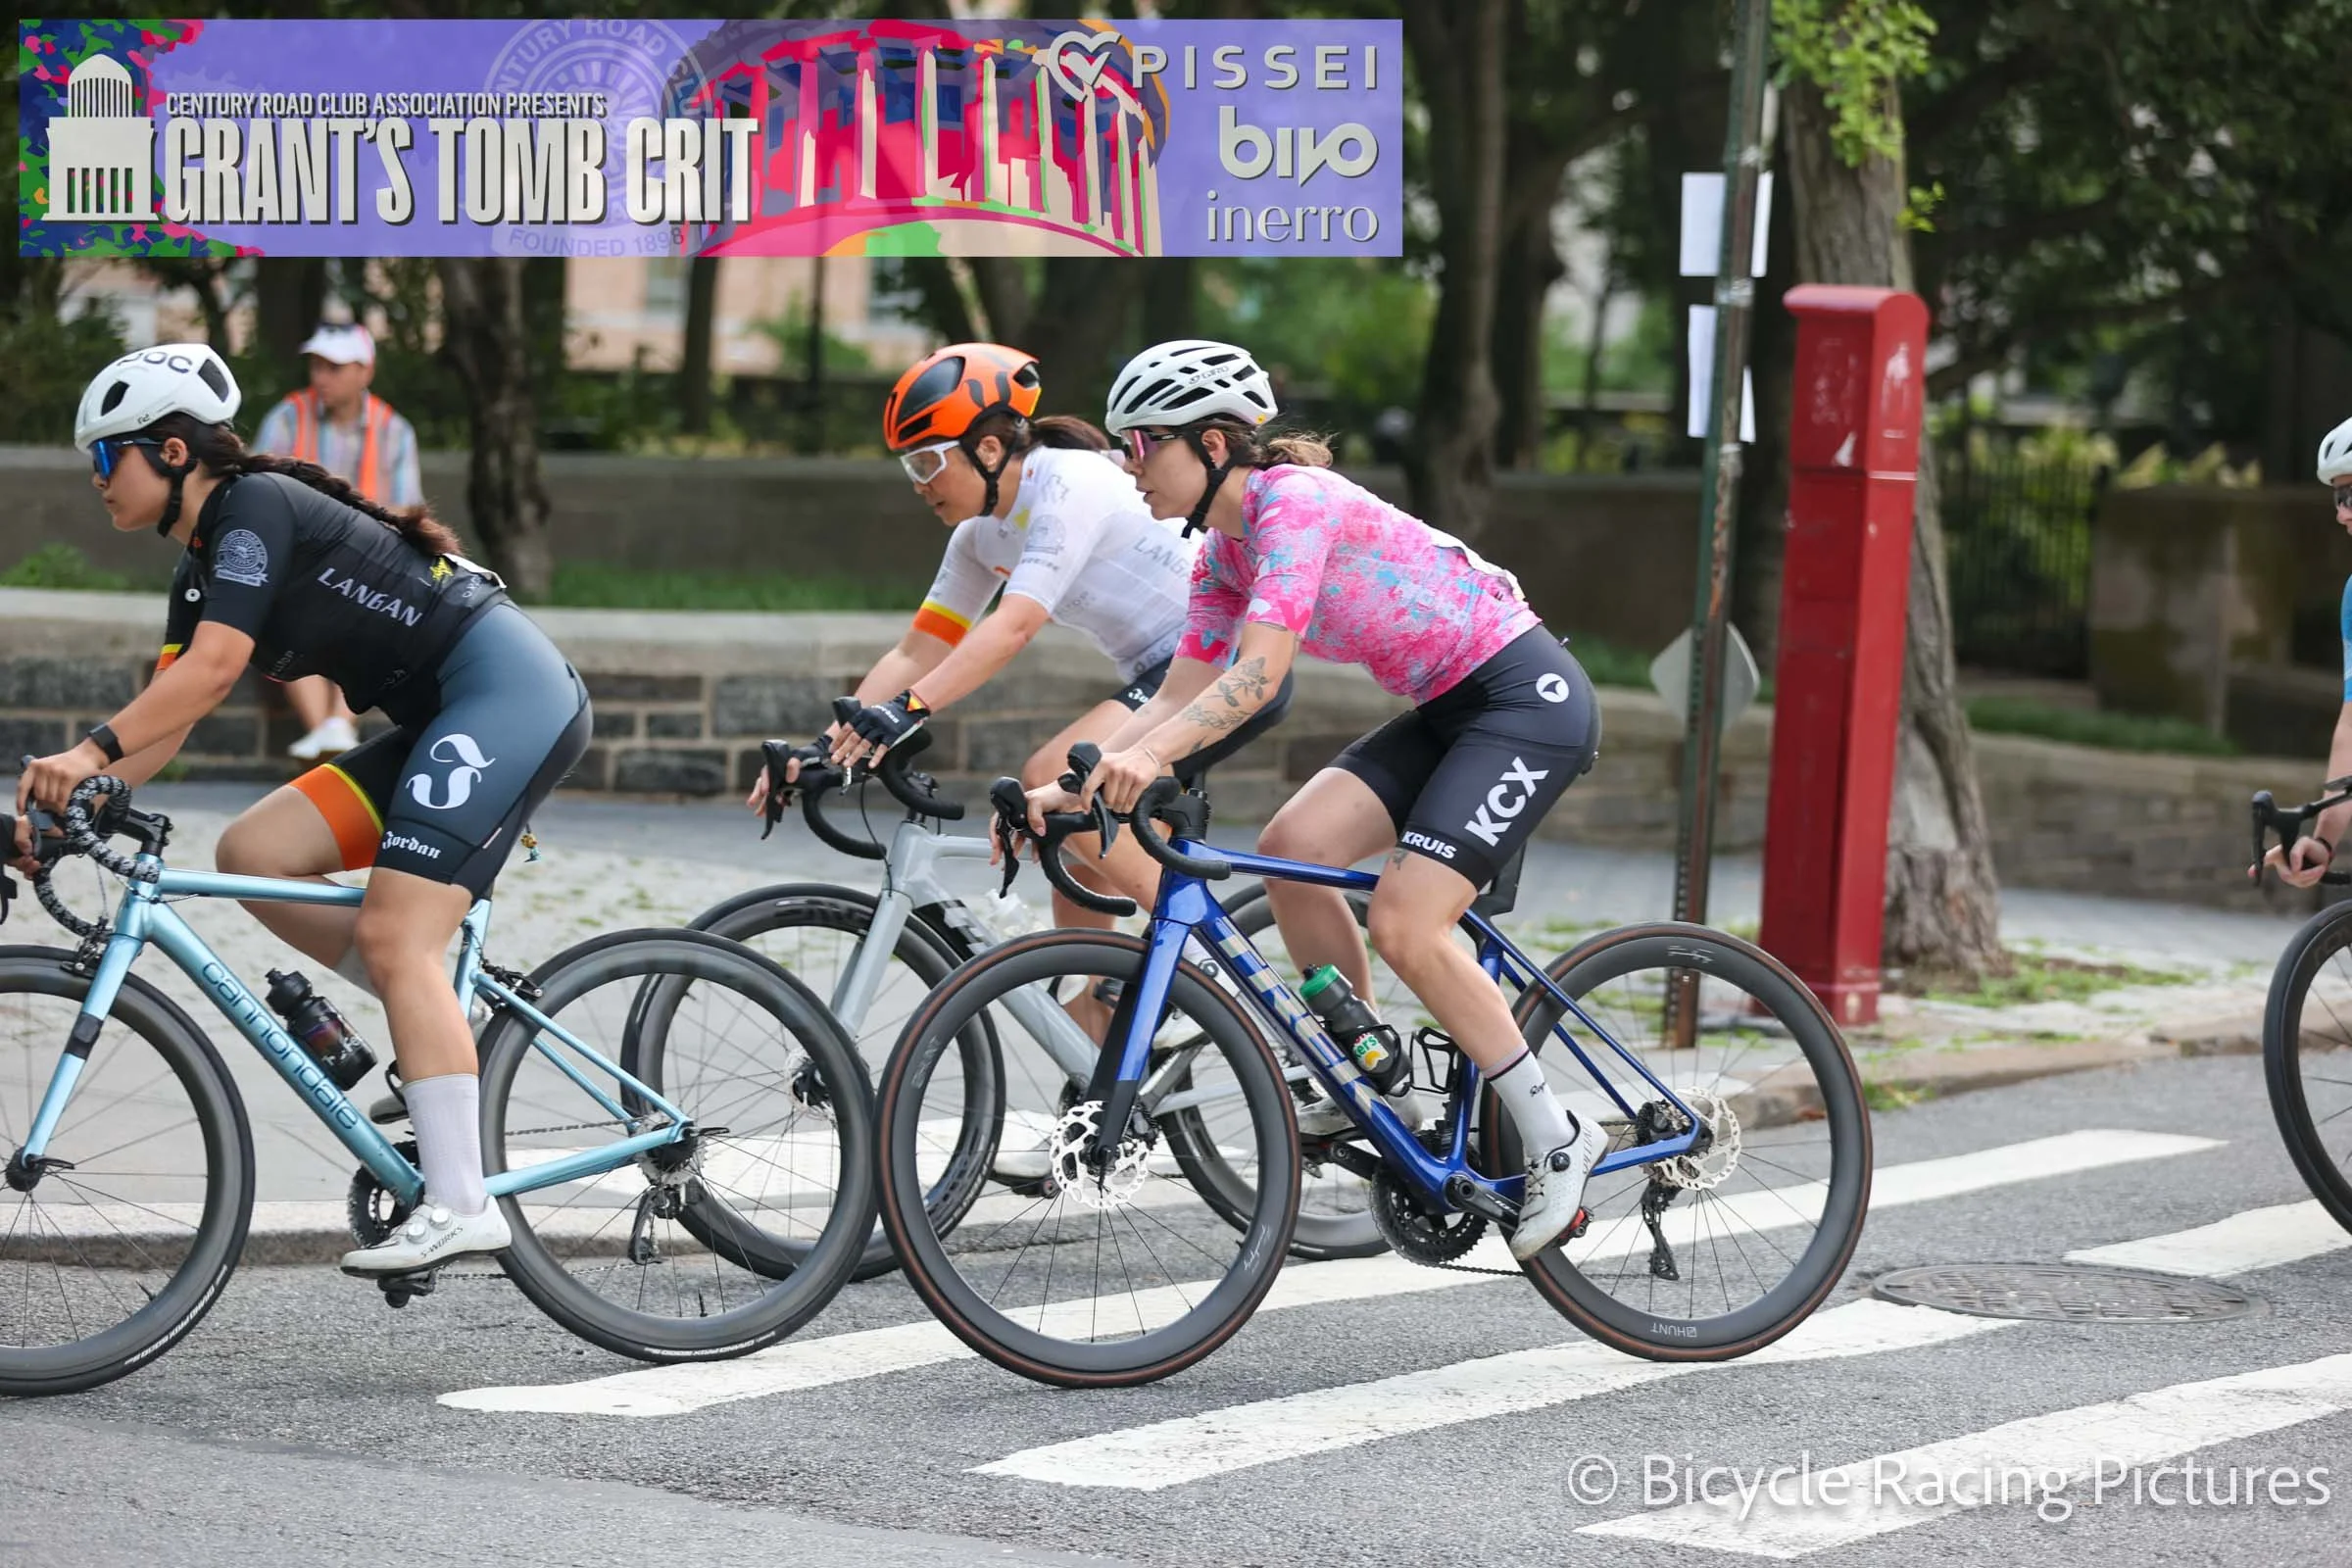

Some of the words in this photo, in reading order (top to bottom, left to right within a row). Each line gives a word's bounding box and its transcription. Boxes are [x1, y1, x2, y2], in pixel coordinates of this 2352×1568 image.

[317, 567, 423, 627] LANGAN
[1464, 756, 1550, 848] KCX
[381, 830, 441, 859] Jordan
[1401, 830, 1457, 859] KRUIS
[1218, 915, 1385, 1119] TREK
[202, 961, 359, 1130] cannondale
[419, 1225, 465, 1258] S-WORKS
[1649, 1322, 1686, 1337] HUNT
